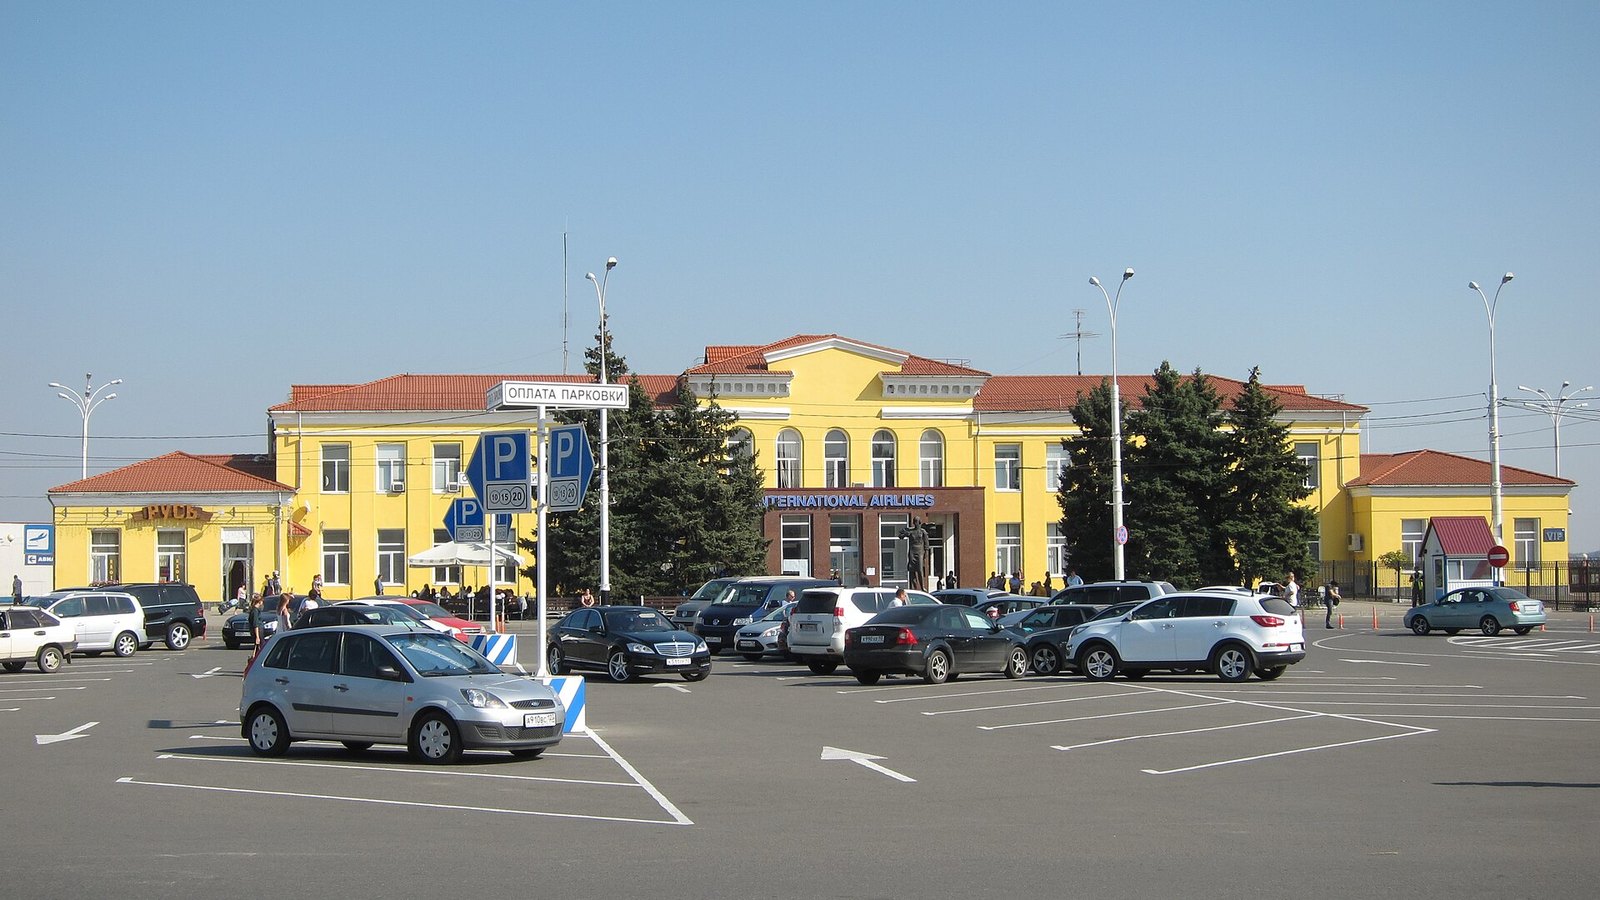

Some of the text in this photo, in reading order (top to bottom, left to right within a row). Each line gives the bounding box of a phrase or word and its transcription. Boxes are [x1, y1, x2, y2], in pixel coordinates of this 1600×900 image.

[508, 387, 557, 400] ОПЛАТА
[561, 389, 624, 402] ПАРКОВКИ
[493, 436, 517, 479] P
[557, 431, 574, 475] P
[501, 493, 509, 501] 15
[512, 492, 522, 501] 20
[567, 488, 575, 498] 20
[761, 494, 935, 508] NTERNATIONAL AIRLINES
[148, 504, 198, 520] РУСЬ
[461, 500, 477, 525] P
[1546, 532, 1563, 540] VIP
